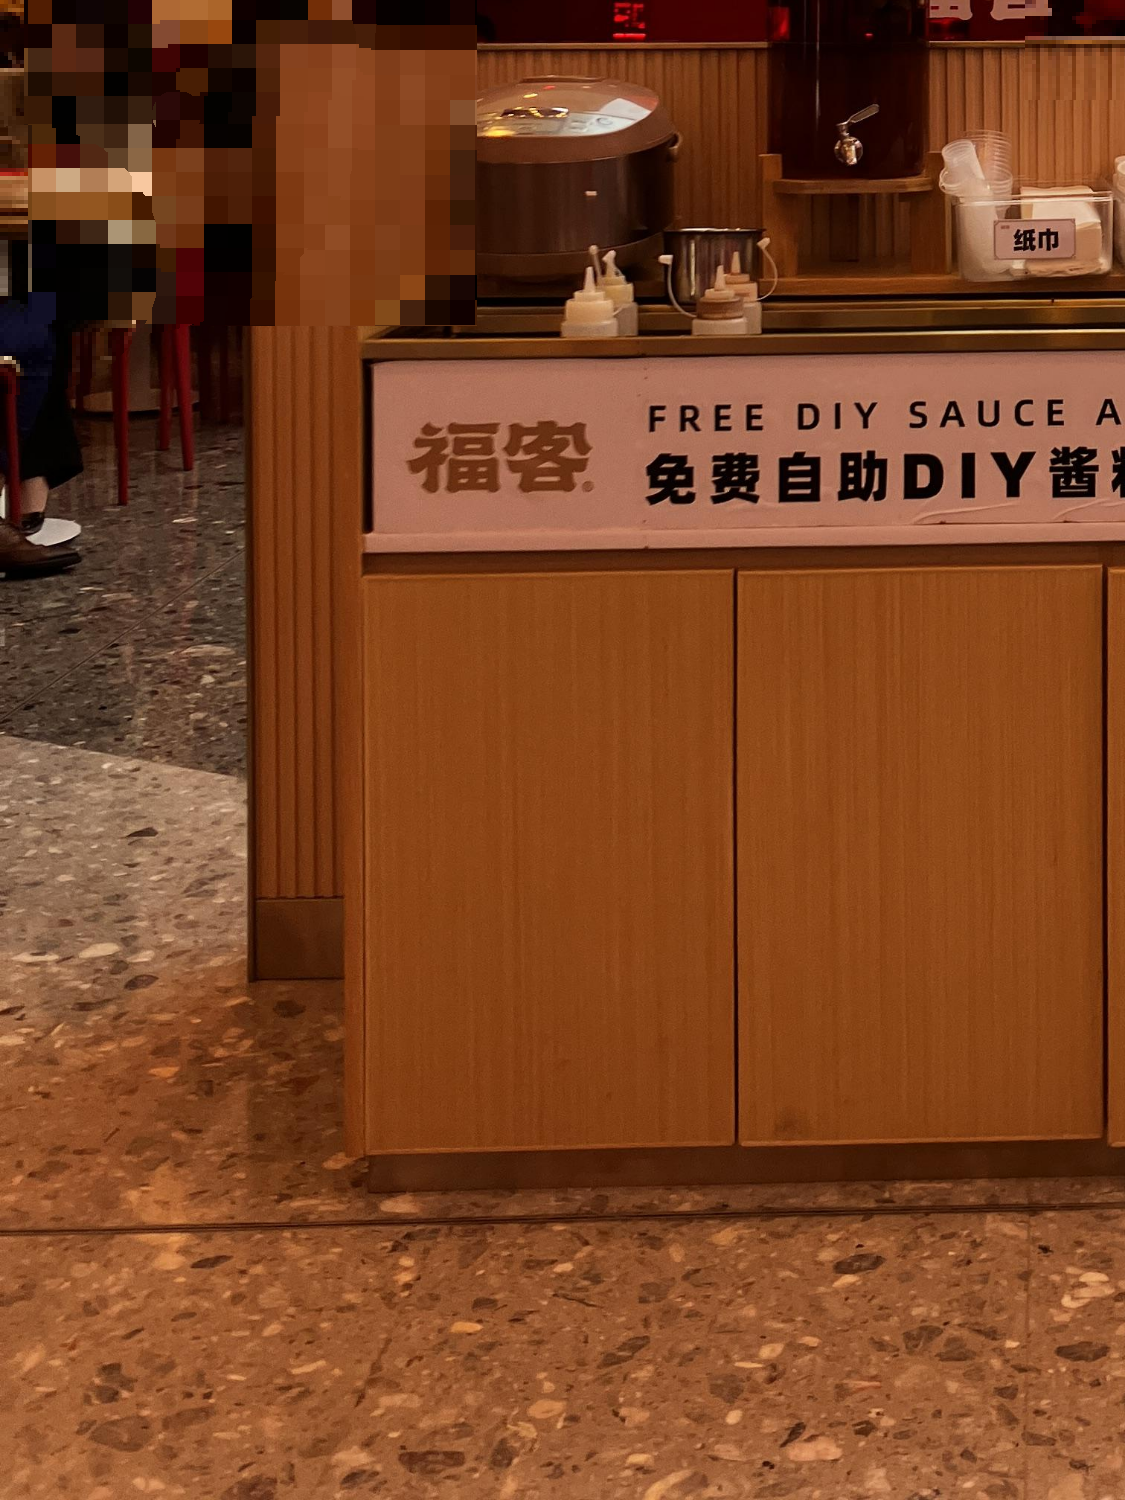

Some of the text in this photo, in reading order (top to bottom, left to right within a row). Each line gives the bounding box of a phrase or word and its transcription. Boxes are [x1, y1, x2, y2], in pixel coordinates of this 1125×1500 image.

[1013, 228, 1060, 252] 纸巾
[648, 404, 765, 432] FREE
[797, 401, 878, 431] DIY
[909, 399, 1065, 429] SAUCE
[406, 420, 593, 493] 福客
